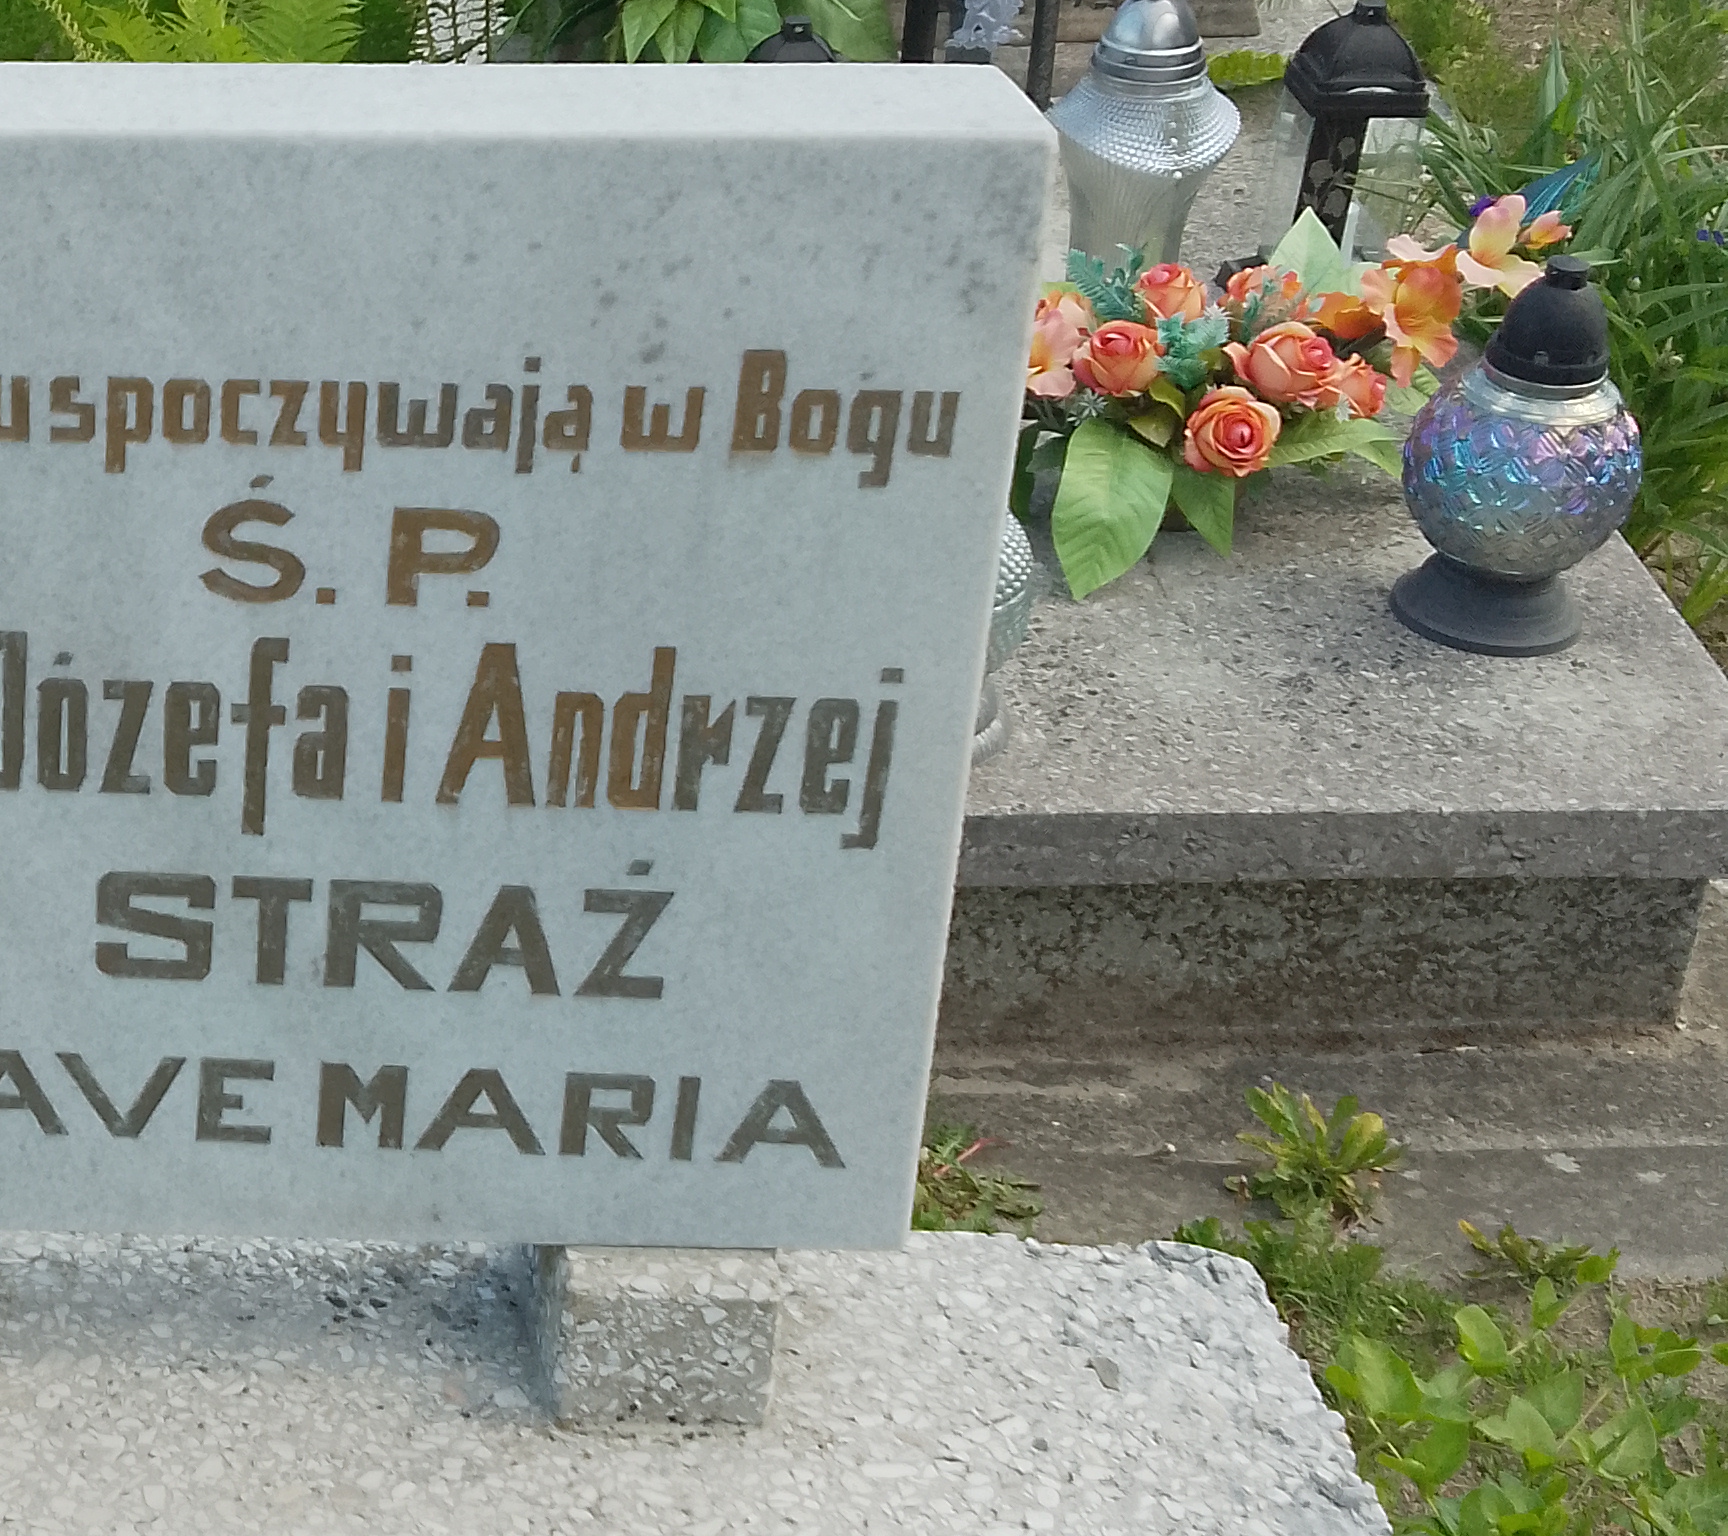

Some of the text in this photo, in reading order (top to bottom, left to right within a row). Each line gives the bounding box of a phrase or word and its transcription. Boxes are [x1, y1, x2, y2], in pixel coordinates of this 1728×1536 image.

[49, 357, 595, 476] spoczywają
[621, 385, 707, 455] w
[729, 349, 962, 490] Bogu
[381, 656, 414, 804] i
[435, 642, 906, 852] Andrzej
[316, 1062, 847, 1170] MARIA
